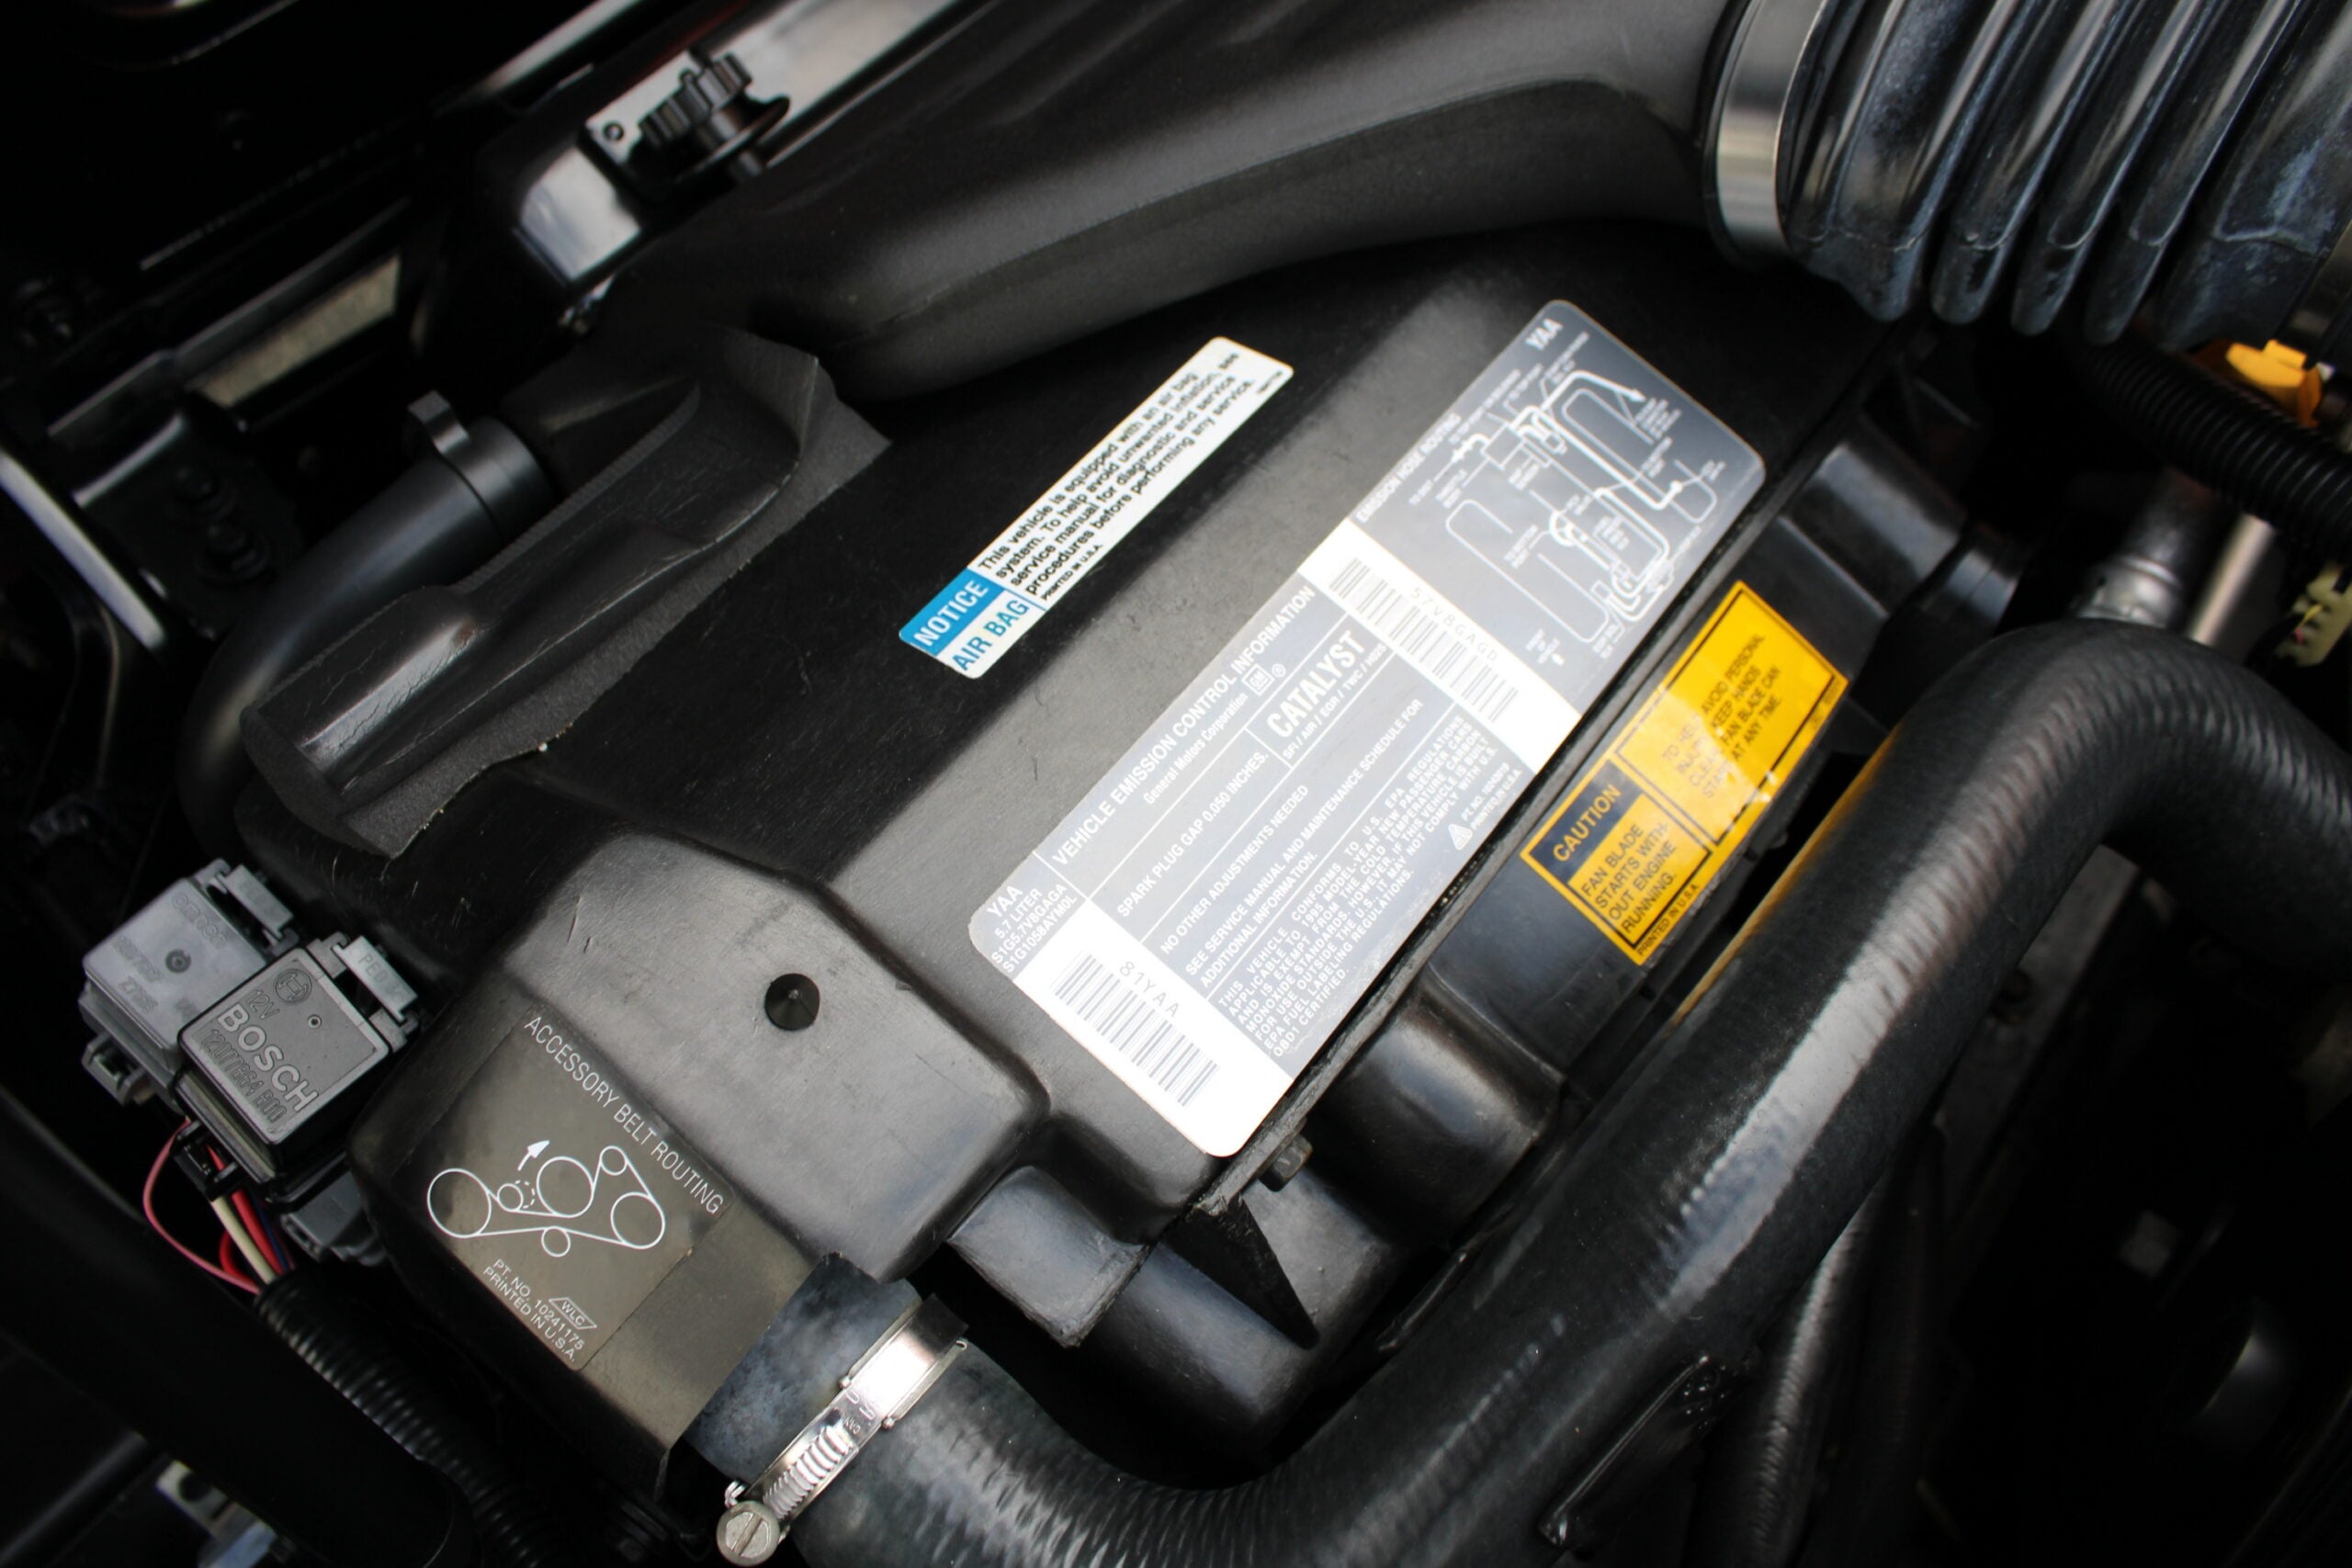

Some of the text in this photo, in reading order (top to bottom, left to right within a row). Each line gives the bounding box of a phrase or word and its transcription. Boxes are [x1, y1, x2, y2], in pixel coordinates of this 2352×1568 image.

[1523, 315, 1564, 353] YAA
[978, 370, 1199, 571] This vehicle is equipped with an air bag
[994, 533, 1047, 580] system.
[1040, 516, 1062, 533] To
[1056, 491, 1090, 519] help
[1083, 461, 1121, 493] avoid
[1116, 412, 1175, 464] unwanted
[1170, 368, 1221, 413] inflation,
[1216, 351, 1239, 370] see
[1007, 543, 1057, 587] service
[1051, 502, 1100, 545] manual
[1093, 484, 1117, 502] for
[1113, 429, 1178, 487] diagnostic
[1170, 410, 1198, 432] and
[1193, 374, 1237, 411] service
[1022, 528, 1097, 595] procedures
[1089, 492, 1133, 530] before
[1127, 434, 1196, 495] performing
[1188, 415, 1216, 438] any
[1209, 376, 1255, 416] service.
[1354, 475, 1403, 525] EMISSION
[1395, 450, 1427, 480] HOSE
[1419, 412, 1463, 456] ROUTING
[911, 580, 989, 647] NOTICE
[1039, 541, 1103, 601] PRINTED U.S.A.
[948, 598, 1030, 671] AIR BAG
[1699, 679, 1729, 715] AVOID
[1722, 629, 1767, 683] PERSONAL
[1051, 584, 1316, 868] VEHICLE EMISSION CONTROL INFORMATION
[1263, 628, 1368, 740] CATALYST
[1282, 669, 1363, 761] SFI AIR EGR TWC
[1708, 662, 1762, 731] KEEP HANDS
[1719, 719, 1742, 746] FAN
[1736, 686, 1767, 724] BLADE
[1758, 662, 1782, 690] CAN
[1141, 690, 1250, 806] General Motors Corporation
[1728, 741, 1747, 761] AT
[1740, 718, 1763, 746] ANY
[1115, 747, 1270, 919] SPARK PLUG GAP 0.050 INCHES.
[1159, 783, 1310, 956] NO OTHER ADJUSTMENTS NEEDED
[1184, 696, 1424, 977] SEE SERVICE MANUAL AND MAINTENANCE SCHEDULE FOR
[1217, 714, 1465, 1010] THIS VEHICLE CONFORMS TO U.S. EPA REGULATIONS
[1227, 720, 1474, 1018] APPLICABLE TO 1995 MODEL-YEAR NEW PASSENGER CARS
[1549, 779, 1622, 866] CAUTION
[1580, 821, 1644, 897] FAN BLADE
[1593, 817, 1669, 911] STARTS WITH-
[985, 881, 1023, 920] YAA
[989, 881, 1068, 964] S1G5.7V8GAGA
[992, 886, 1043, 940] 5.7 LITER
[1198, 848, 1318, 988] ADDITIONAL INFORMATION.
[1236, 728, 1482, 1026] AND IS EXEMPT FROM THE COLD TEMPERATURE CARBON
[1245, 735, 1491, 1034] MONOXIDE STANDARDS. HOWEVER, IF THIS VEHICLE IS BUILT
[1254, 1014, 1279, 1043] FOR
[1275, 989, 1299, 1017] USE
[1295, 941, 1339, 991] OUTSIDE
[1335, 917, 1358, 942] THE
[1374, 878, 1389, 893] IT
[1385, 854, 1408, 880] MAY
[1404, 831, 1427, 857] NOT
[1423, 789, 1461, 834] COMPLY
[1456, 763, 1482, 793] WITH
[1477, 742, 1499, 767] U.S.
[1606, 837, 1677, 923] OUT ENGINE
[1620, 863, 1677, 937] RUNNING.
[1262, 864, 1414, 1051] EPA FUEL LABELING REGULATIONS.
[1636, 905, 1679, 958] PRINTED IN
[243, 987, 280, 1023] 12V
[1117, 958, 1182, 1020] 81YAA
[1297, 964, 1350, 1027] CERTIFIED.
[214, 1001, 319, 1112] BOSCH
[523, 1010, 726, 1216] ACCESSORY BELT ROUTING
[482, 1264, 580, 1363] PRINTED IN U.S.A.
[492, 1257, 585, 1352] PT. NO. 10241175
[559, 1299, 586, 1328] WLC
